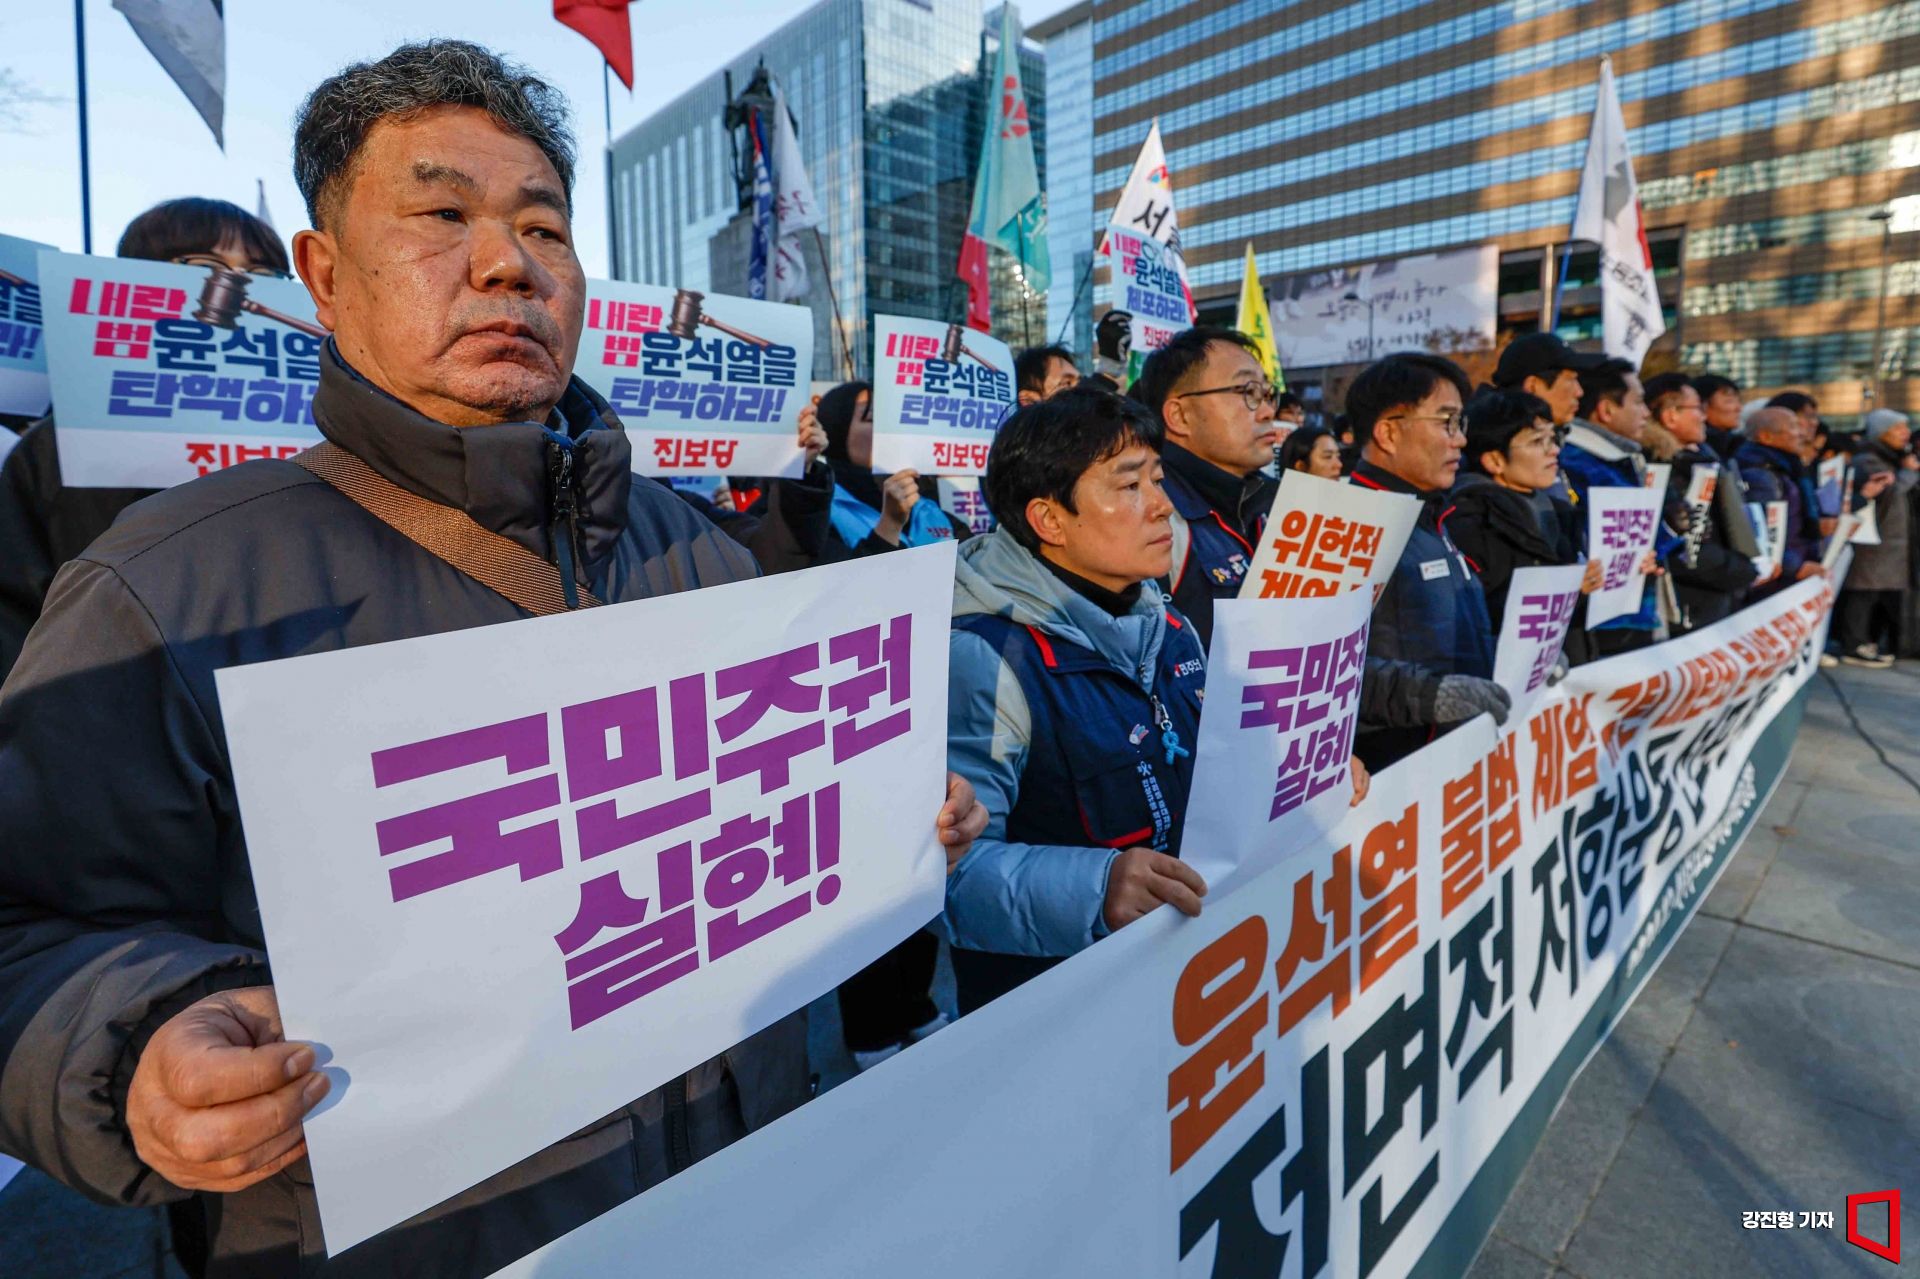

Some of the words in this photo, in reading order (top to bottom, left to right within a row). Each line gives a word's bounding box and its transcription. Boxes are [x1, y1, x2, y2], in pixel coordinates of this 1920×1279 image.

[69, 278, 187, 321] 내란
[588, 298, 663, 334] 내란
[886, 333, 940, 360] 내란
[107, 370, 317, 425] 탄핵하
[611, 377, 787, 423] 탄핵하라!
[653, 438, 738, 468] 진보당
[933, 442, 989, 468] 진보당
[1272, 510, 1385, 577] 위헌적
[371, 613, 912, 902] 국민주권
[1268, 713, 1354, 823] 실현!
[554, 781, 842, 1031] 실현!
[1166, 802, 1419, 1176] 윤석열
[1440, 735, 1522, 920] 불법
[1529, 690, 1600, 823] 계엄
[1178, 867, 1515, 1279] 전면적
